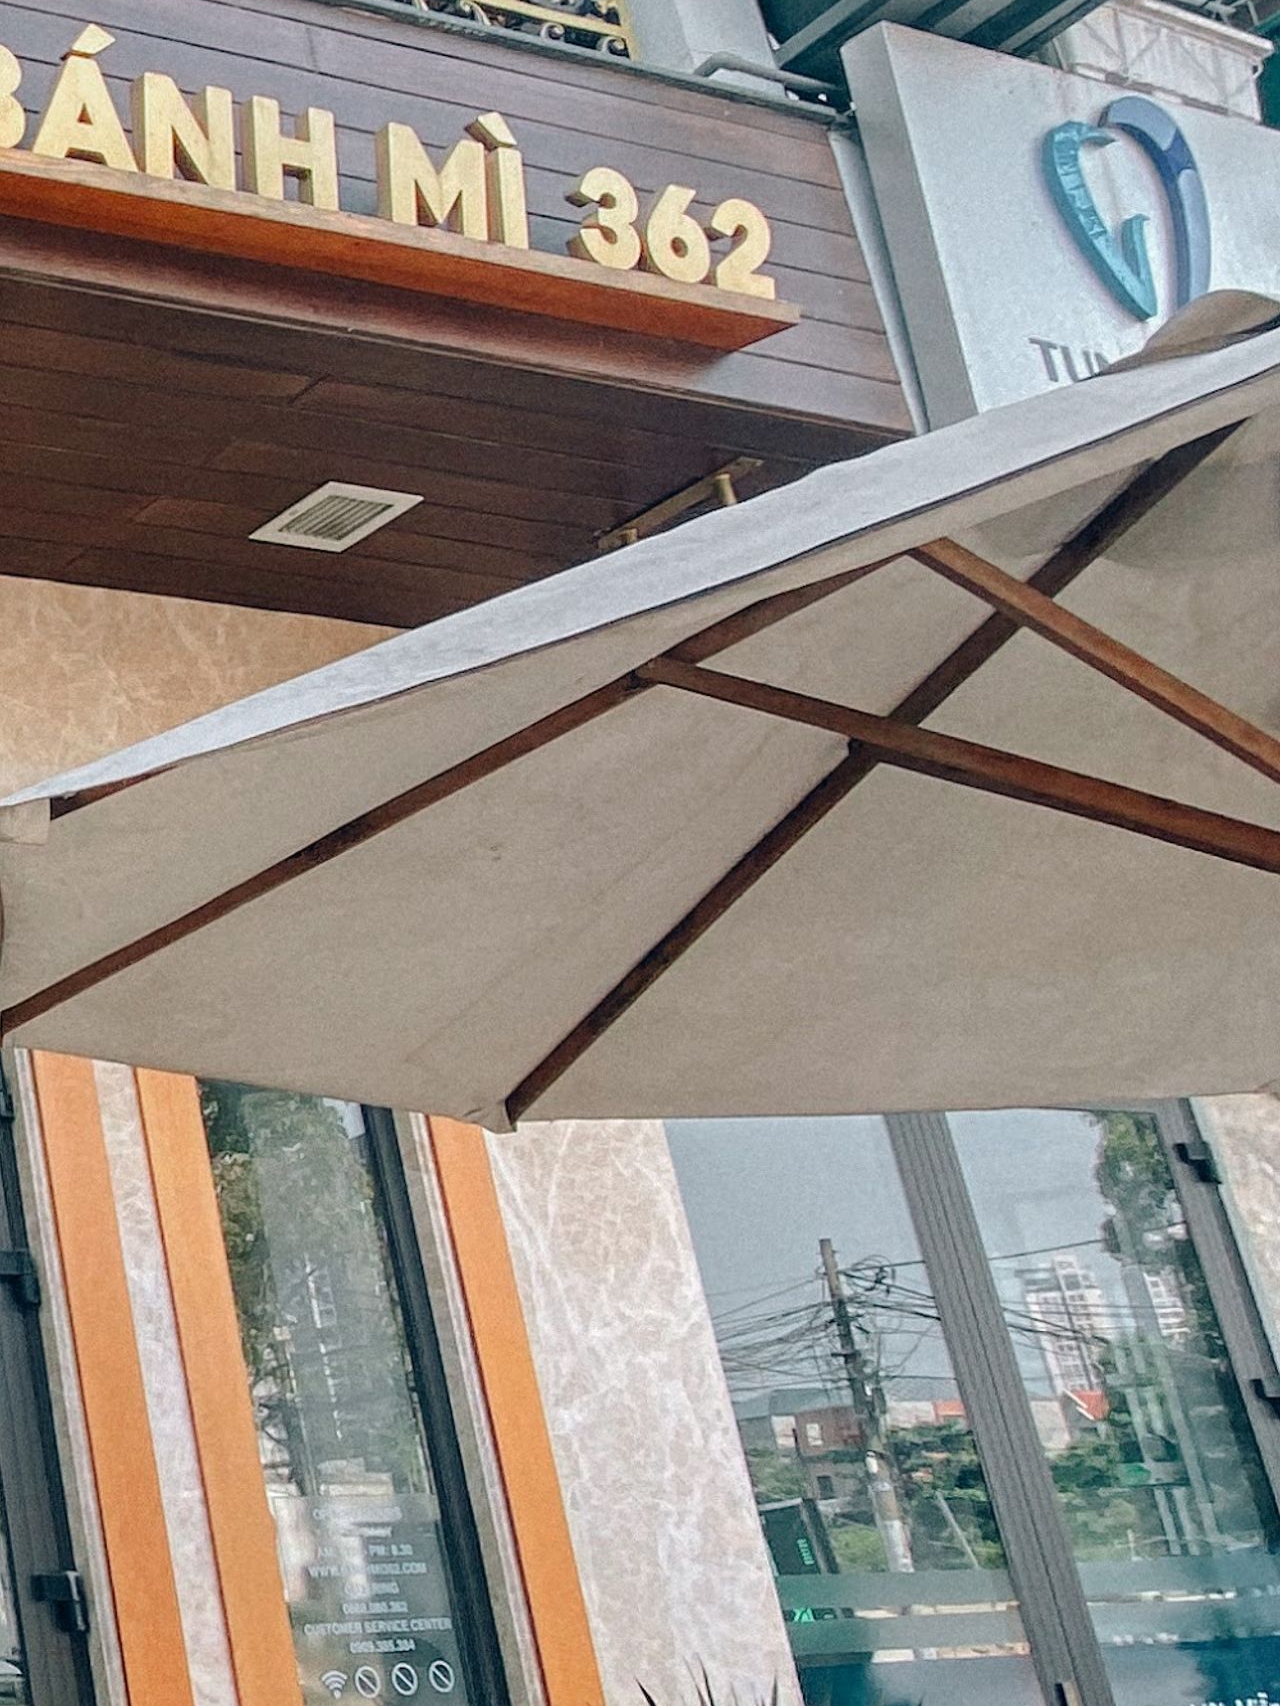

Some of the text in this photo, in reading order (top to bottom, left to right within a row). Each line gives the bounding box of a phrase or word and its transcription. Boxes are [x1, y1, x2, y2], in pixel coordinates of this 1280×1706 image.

[376, 111, 529, 250] MÌ
[565, 167, 776, 300] 362
[304, 1617, 453, 1635] CUSTOMER SERVICE CENTER
